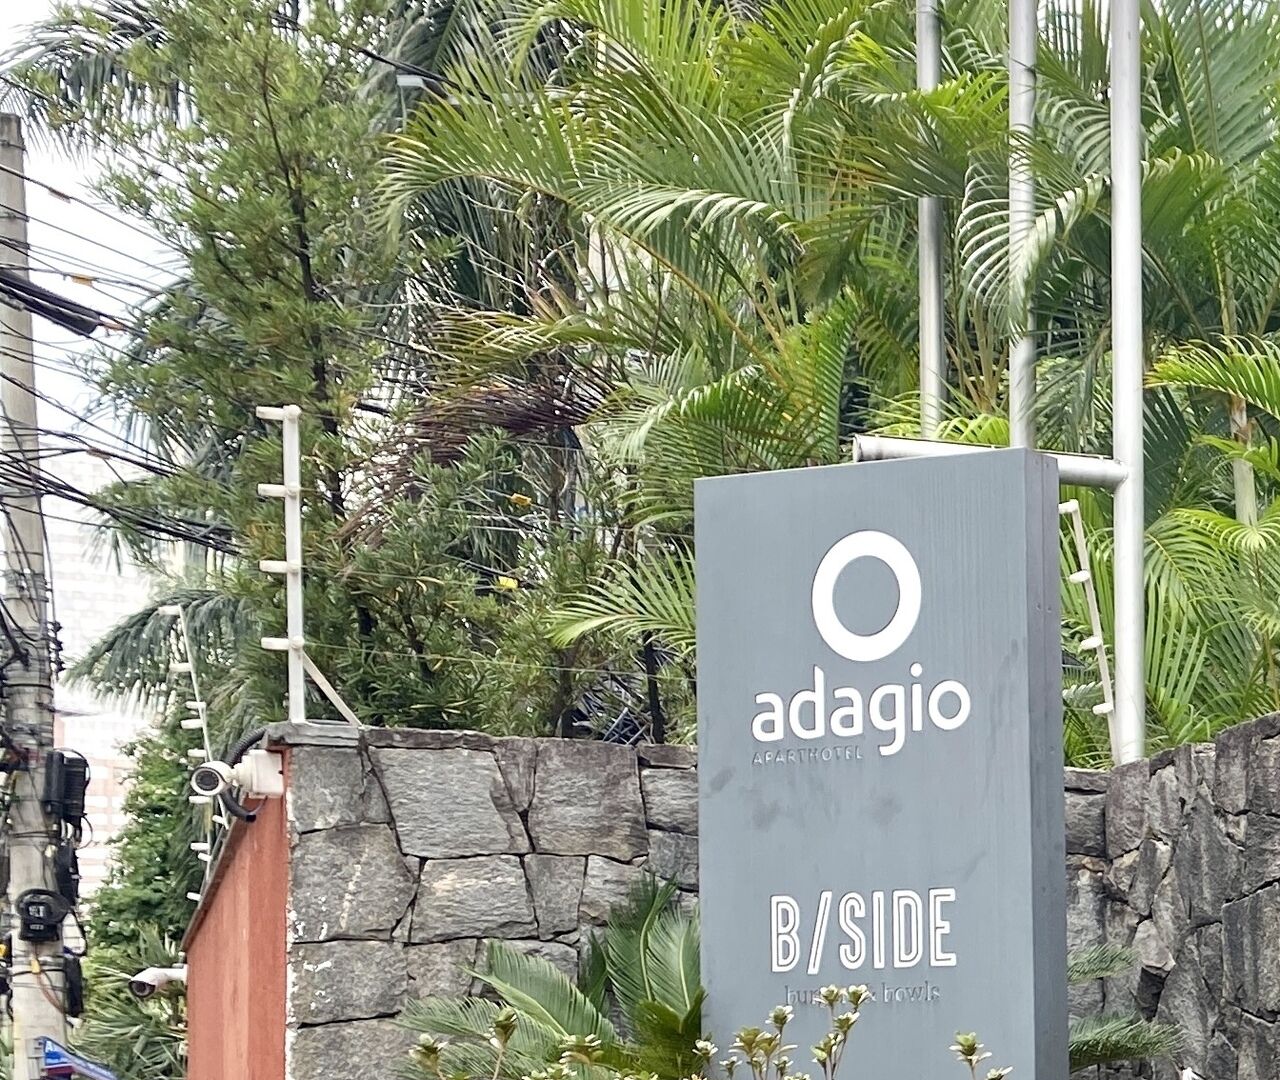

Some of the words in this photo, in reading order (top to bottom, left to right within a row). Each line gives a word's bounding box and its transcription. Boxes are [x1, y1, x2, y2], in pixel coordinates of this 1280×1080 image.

[751, 662, 971, 756] adagio
[752, 745, 864, 766] APARTHOTEL
[770, 887, 957, 975] B/SIDE
[881, 980, 941, 1003] bowls
